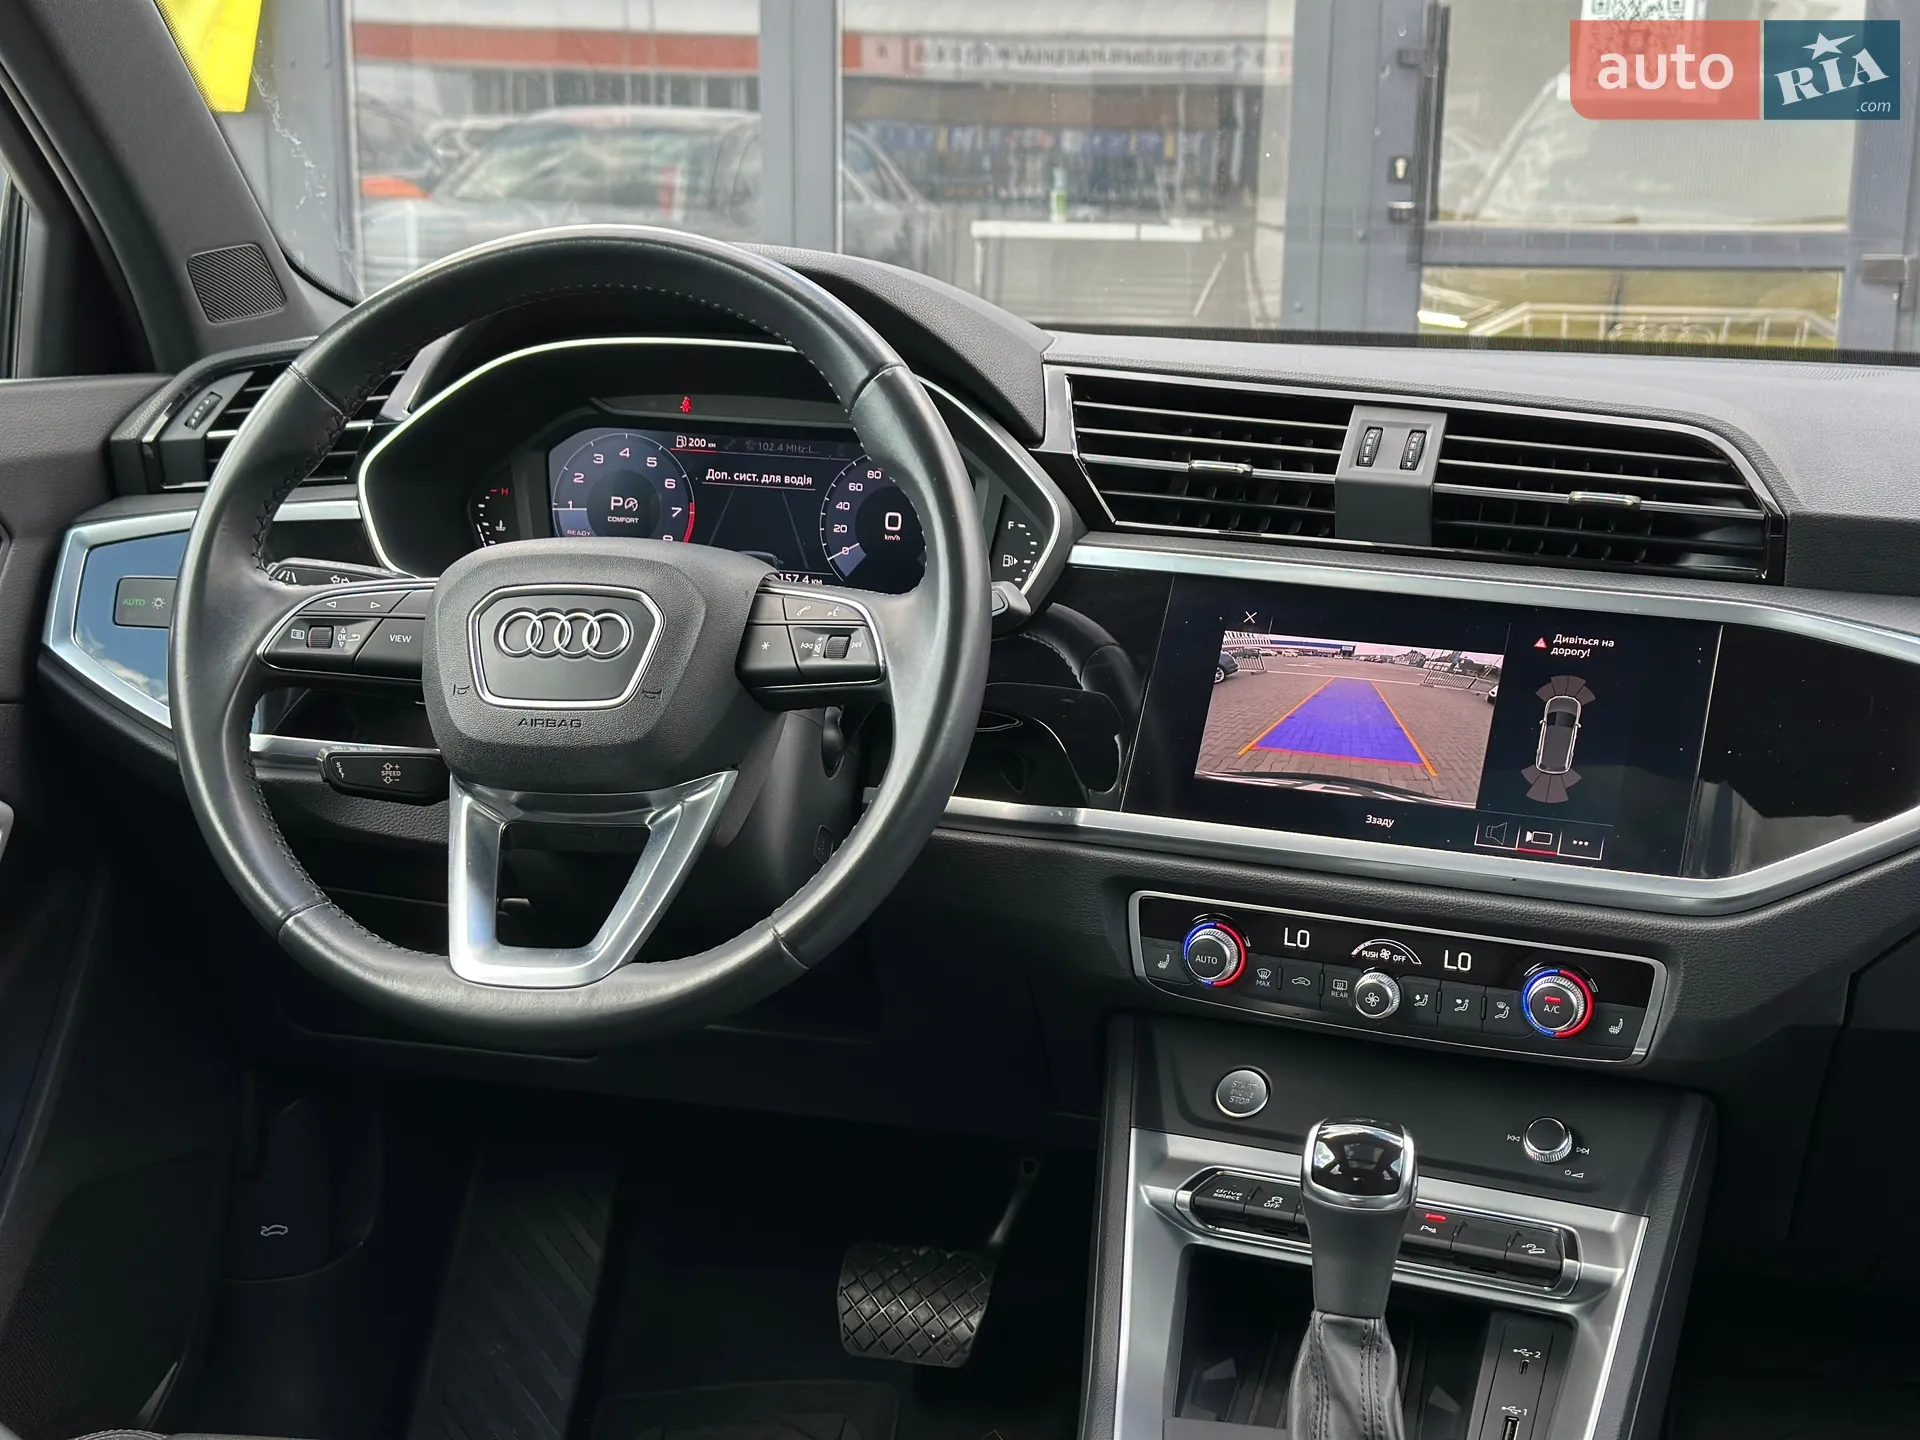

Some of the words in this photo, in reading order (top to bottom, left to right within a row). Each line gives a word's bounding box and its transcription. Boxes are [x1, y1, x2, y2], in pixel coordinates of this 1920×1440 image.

[688, 437, 707, 448] 200
[758, 441, 784, 452] 102.4
[619, 447, 631, 458] 4
[593, 453, 604, 464] 3
[646, 456, 658, 468] 5
[573, 472, 585, 484] 2
[705, 468, 731, 481] Доп.
[733, 472, 759, 483] сист.
[761, 473, 782, 485] для
[784, 476, 813, 486] водія
[867, 470, 882, 479] 80
[664, 478, 676, 489] 6
[848, 483, 863, 492] 60
[568, 500, 573, 510] 1
[610, 496, 623, 511] P
[836, 502, 850, 511] 40
[671, 507, 682, 518] 7
[607, 515, 639, 524] COMFORT
[884, 511, 902, 531] 0
[833, 524, 848, 533] 20
[1007, 521, 1015, 530] F
[841, 546, 850, 555] 0
[122, 598, 146, 607] AUTO
[337, 633, 347, 641] OK
[389, 634, 412, 643] VIEW
[1553, 634, 1599, 646] Дивіться
[1601, 639, 1615, 648] на
[1550, 647, 1591, 658] дорогу!
[517, 718, 582, 728] AIRBAG
[1365, 814, 1395, 828] Ззаду
[1283, 927, 1310, 948] LO
[1195, 955, 1218, 965] AUTO
[1361, 950, 1379, 959] PUSH
[1392, 954, 1407, 963] OFF
[1444, 949, 1472, 971] LO
[1256, 979, 1271, 988] MAX
[1331, 991, 1348, 999] REAR
[1543, 1005, 1560, 1014] A/C
[1228, 1095, 1250, 1105] STOP
[1212, 1192, 1241, 1201] select
[1216, 1188, 1243, 1197] drive
[1534, 1351, 1541, 1359] 2
[1523, 1408, 1528, 1416] 1
